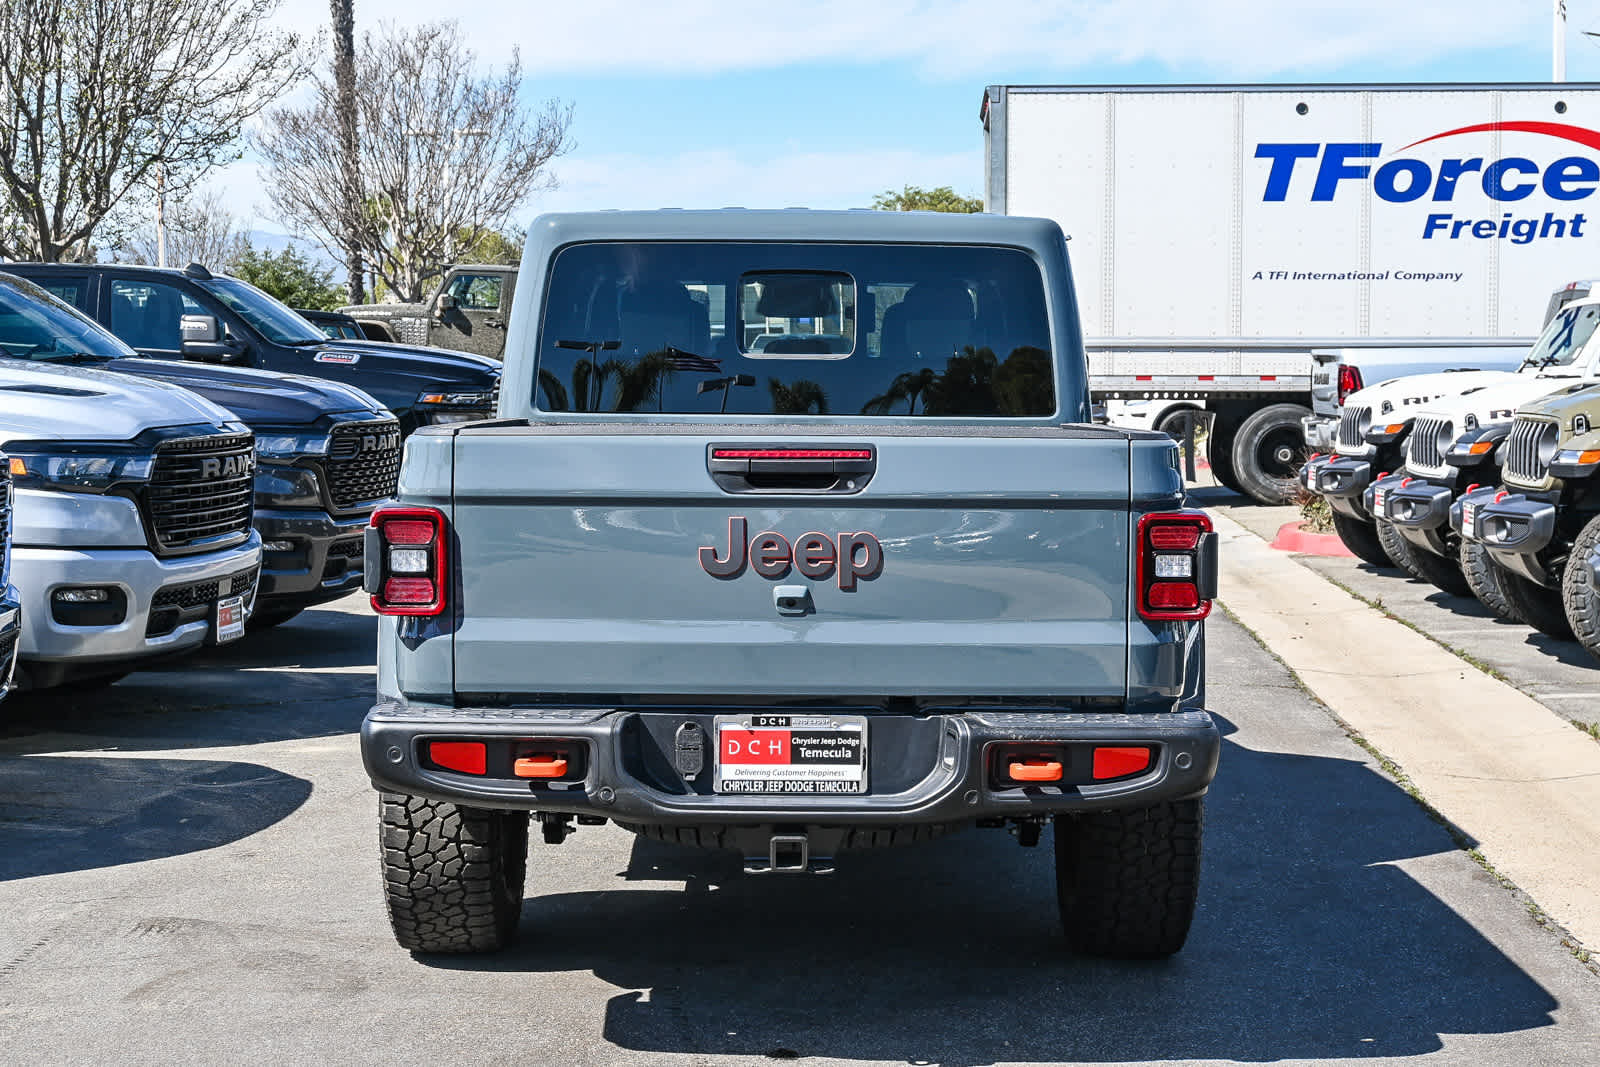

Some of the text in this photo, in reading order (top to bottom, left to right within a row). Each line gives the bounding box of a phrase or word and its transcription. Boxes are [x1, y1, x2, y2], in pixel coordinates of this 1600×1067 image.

[1254, 142, 1600, 203] TForce
[1422, 212, 1587, 244] Freight
[1252, 270, 1463, 282] A TFI International Company
[363, 433, 399, 451] RAM
[202, 454, 249, 478] RAM
[698, 516, 883, 590] Jeep
[791, 737, 860, 747] Chrysler Jeep Dodge
[799, 747, 852, 758] Temecula
[734, 768, 845, 778] Delivering Customer Happiness
[723, 781, 859, 792] CHRYSLER JEEP DODGE TEMECULA
